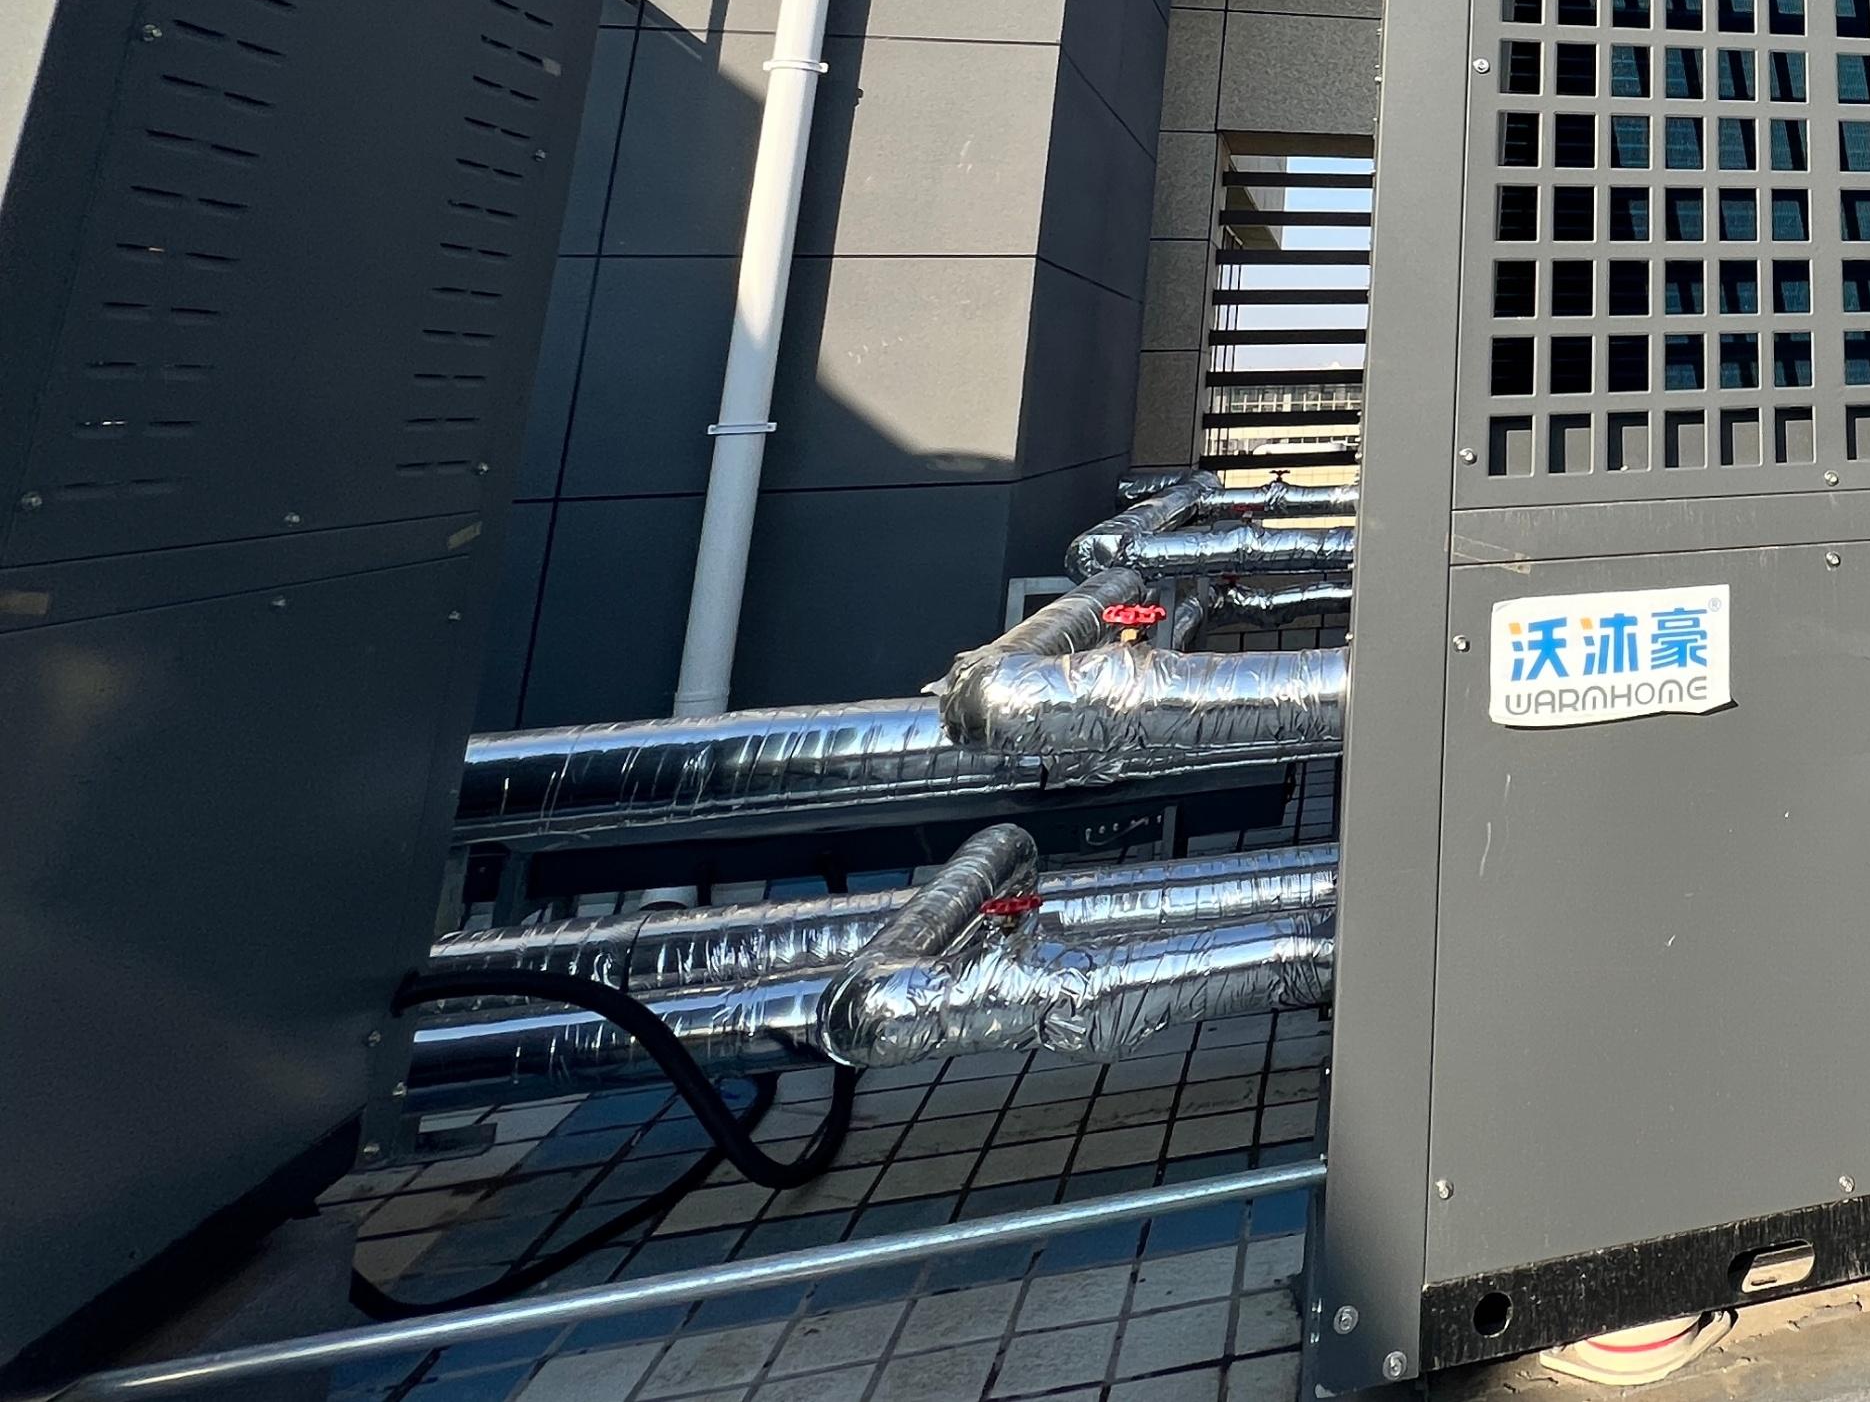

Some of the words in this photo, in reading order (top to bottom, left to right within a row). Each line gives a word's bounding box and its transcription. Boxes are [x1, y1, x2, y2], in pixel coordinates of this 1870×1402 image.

[1508, 607, 1708, 682] 沃沐豪
[1505, 675, 1708, 716] WARMHOME
